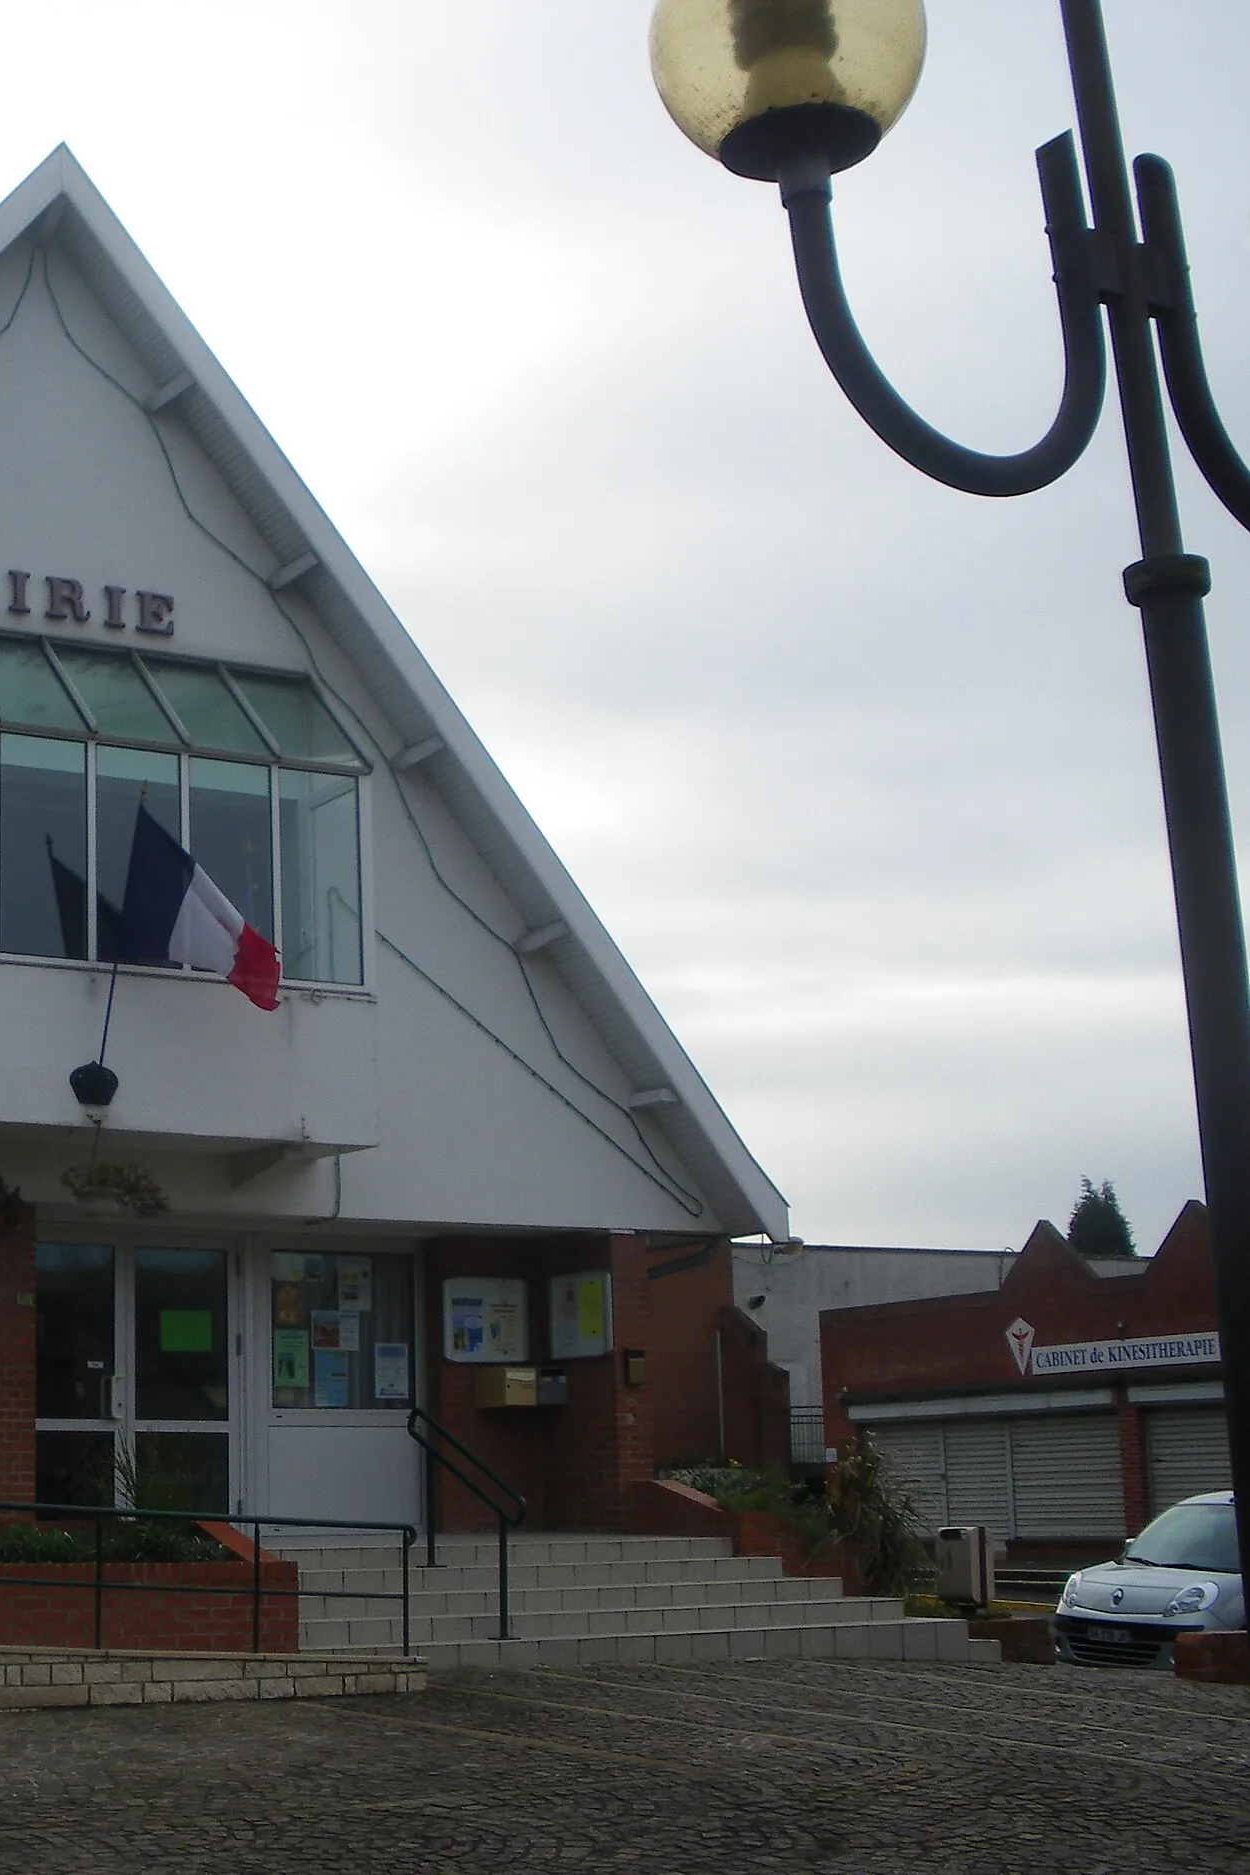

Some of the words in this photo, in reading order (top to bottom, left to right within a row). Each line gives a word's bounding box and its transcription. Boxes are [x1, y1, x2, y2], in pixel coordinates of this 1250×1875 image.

[1036, 1348, 1087, 1368] CABINET
[1090, 1347, 1104, 1363] de
[1108, 1338, 1216, 1362] KINESITHERAPIE
